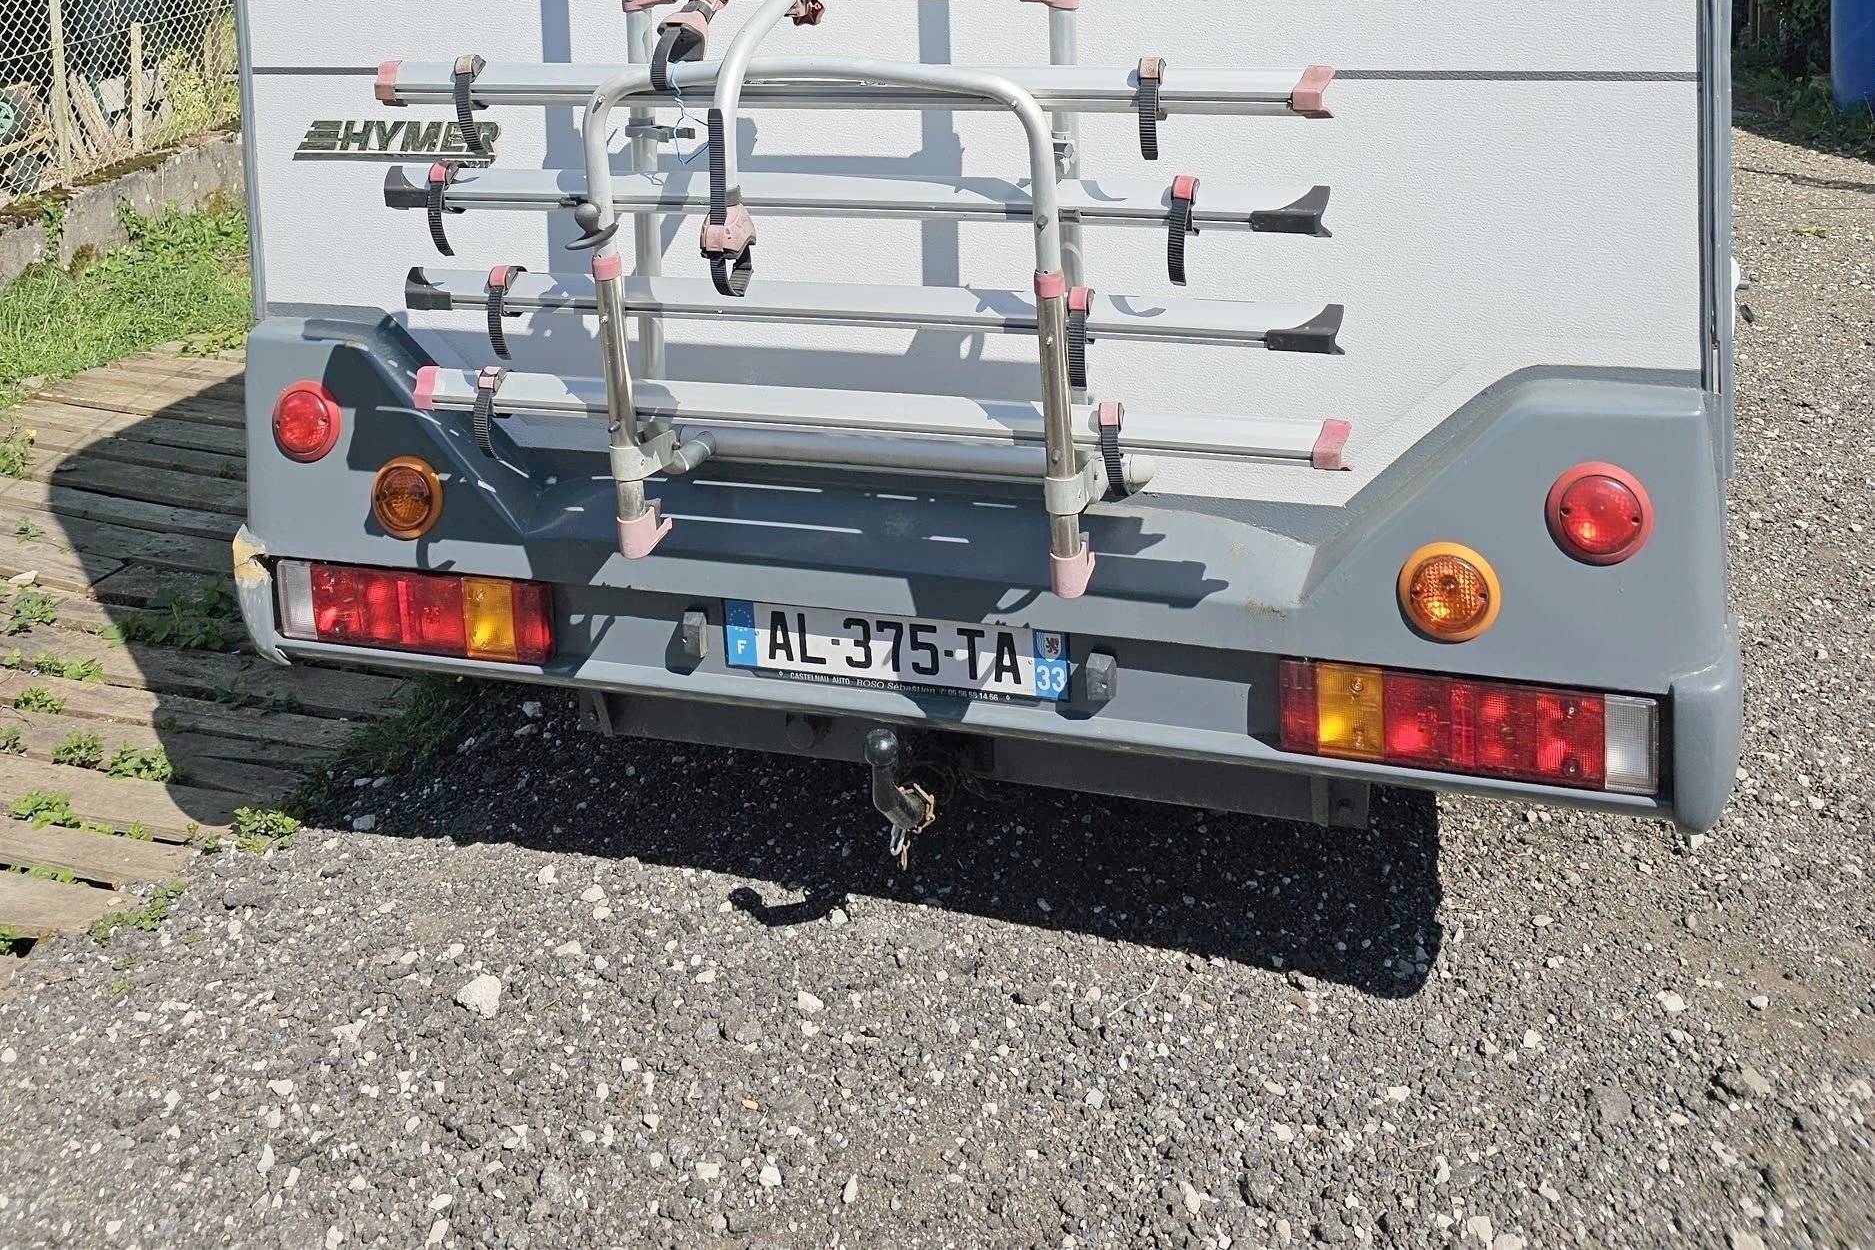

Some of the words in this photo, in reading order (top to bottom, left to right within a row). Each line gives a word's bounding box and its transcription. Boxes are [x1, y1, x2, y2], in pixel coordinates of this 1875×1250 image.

[736, 639, 747, 655] F
[768, 610, 1022, 685] AL-375-TA
[790, 672, 830, 683] CASTELNAU
[832, 676, 850, 685] AUTO
[1036, 665, 1066, 693] 33
